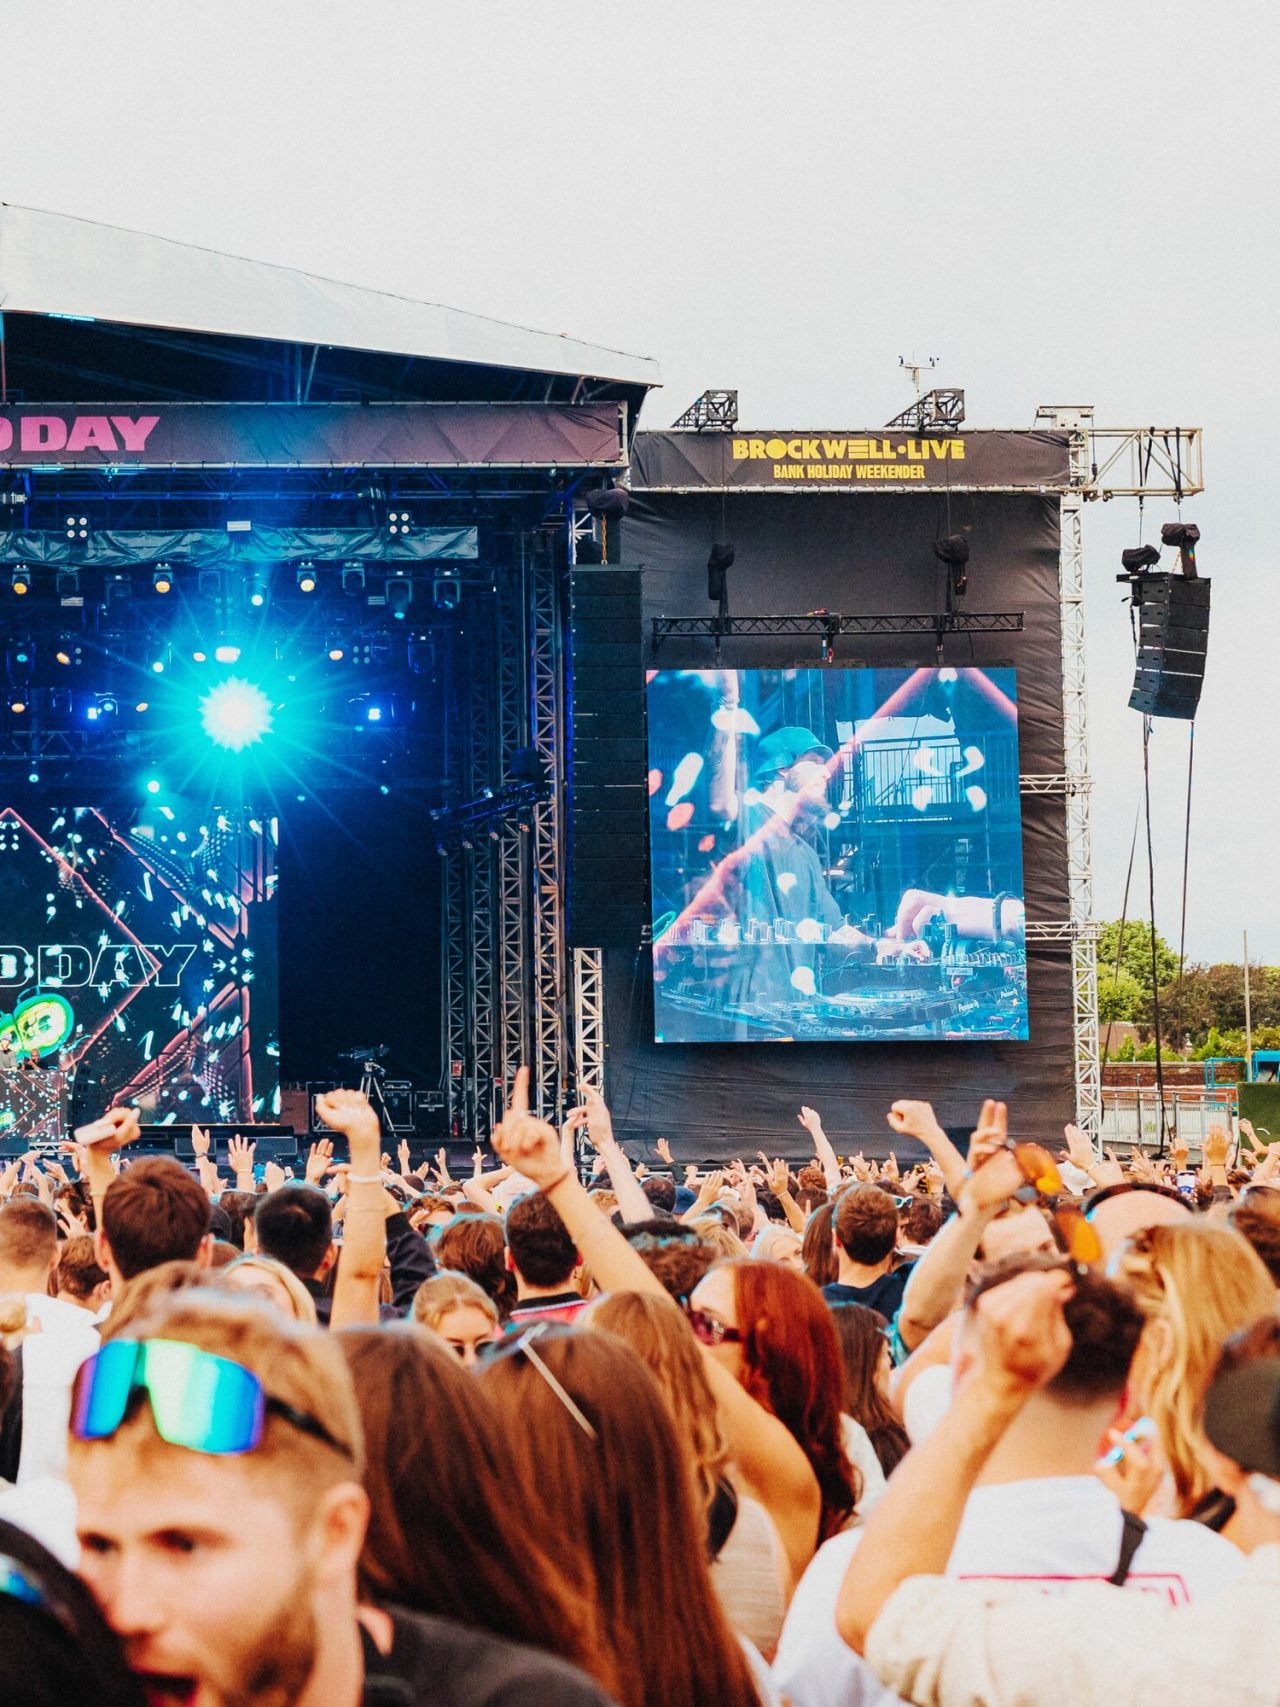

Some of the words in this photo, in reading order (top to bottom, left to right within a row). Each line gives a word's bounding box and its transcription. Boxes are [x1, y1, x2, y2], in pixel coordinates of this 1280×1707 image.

[21, 416, 160, 452] DAY
[773, 464, 805, 479] BANK
[807, 464, 853, 479] HOLIDAY
[856, 464, 925, 479] WEEKENDER
[37, 944, 198, 988] DAY
